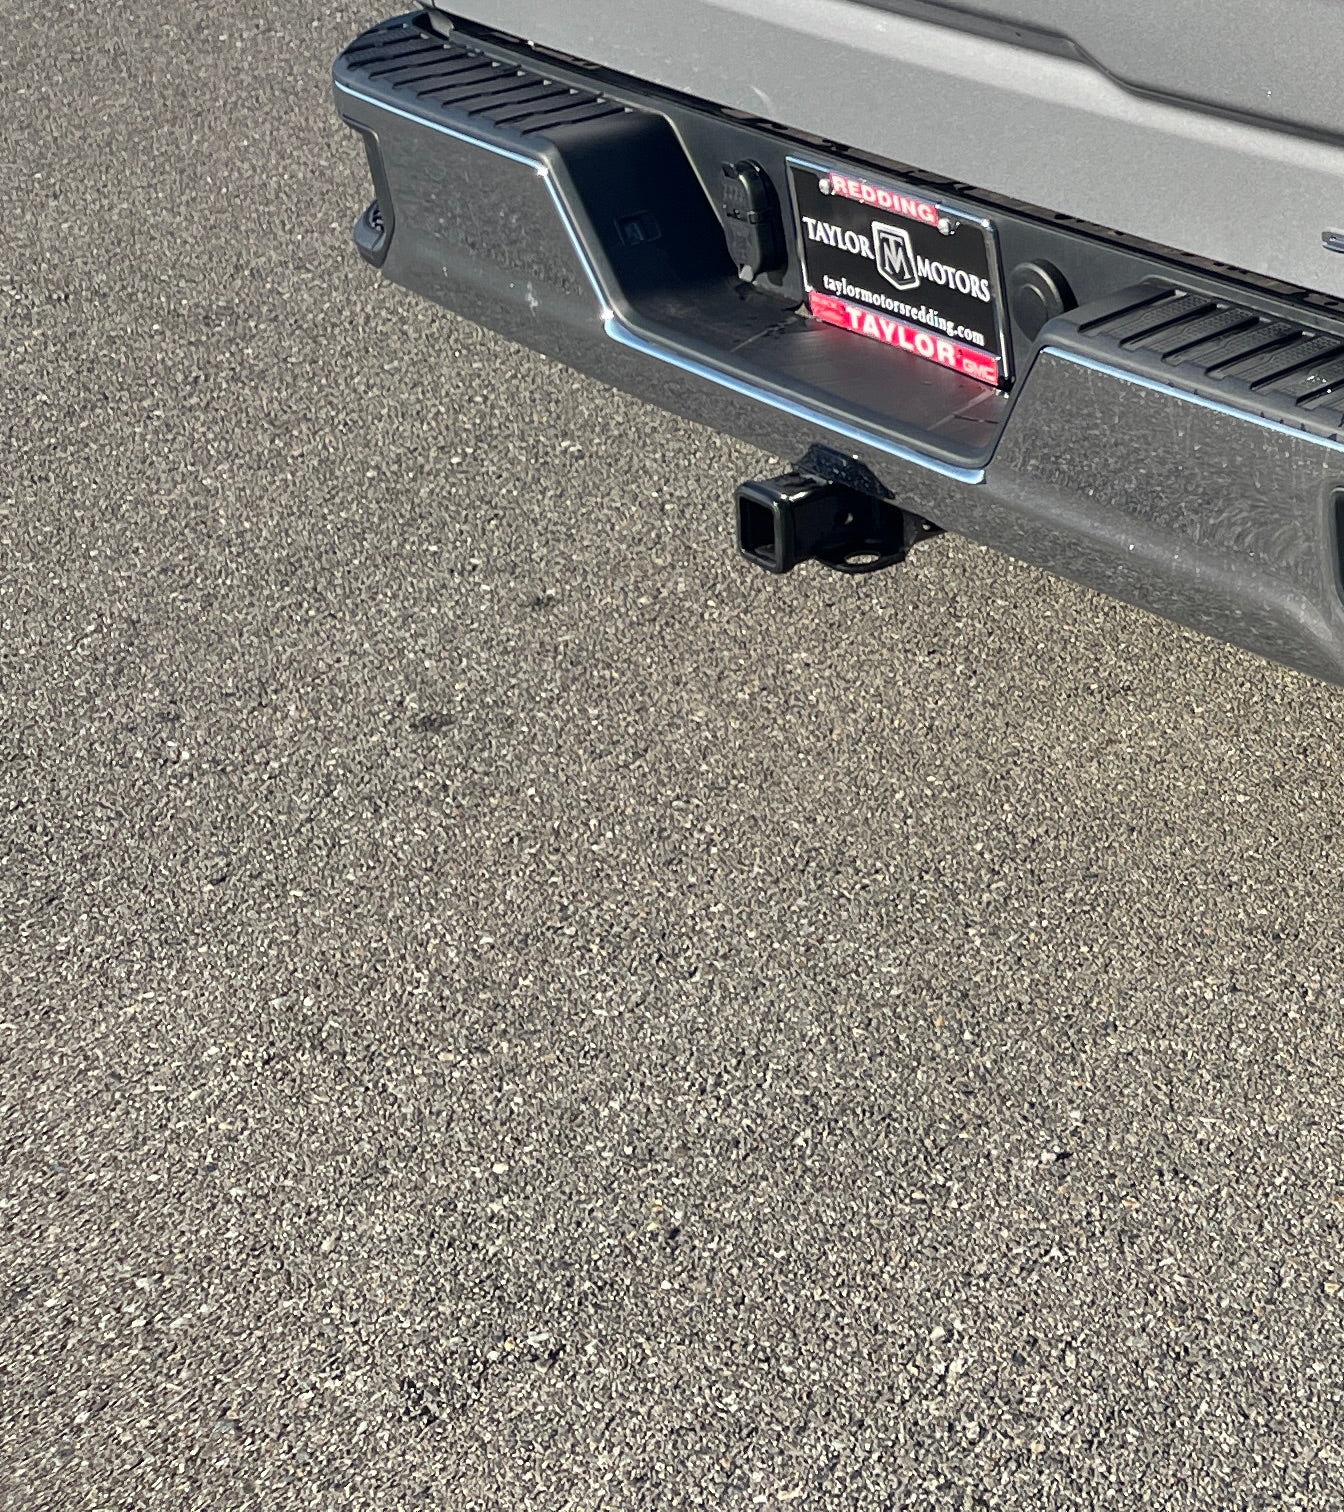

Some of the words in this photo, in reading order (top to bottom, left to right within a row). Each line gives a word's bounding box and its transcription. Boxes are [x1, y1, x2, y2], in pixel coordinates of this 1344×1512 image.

[832, 175, 936, 224] REDDING
[802, 216, 875, 260] TAYLOR
[916, 254, 991, 303] MOTORS
[823, 274, 985, 347] taylormotorsredding.com
[845, 305, 956, 365] TAYLOR
[962, 359, 996, 382] GMC
